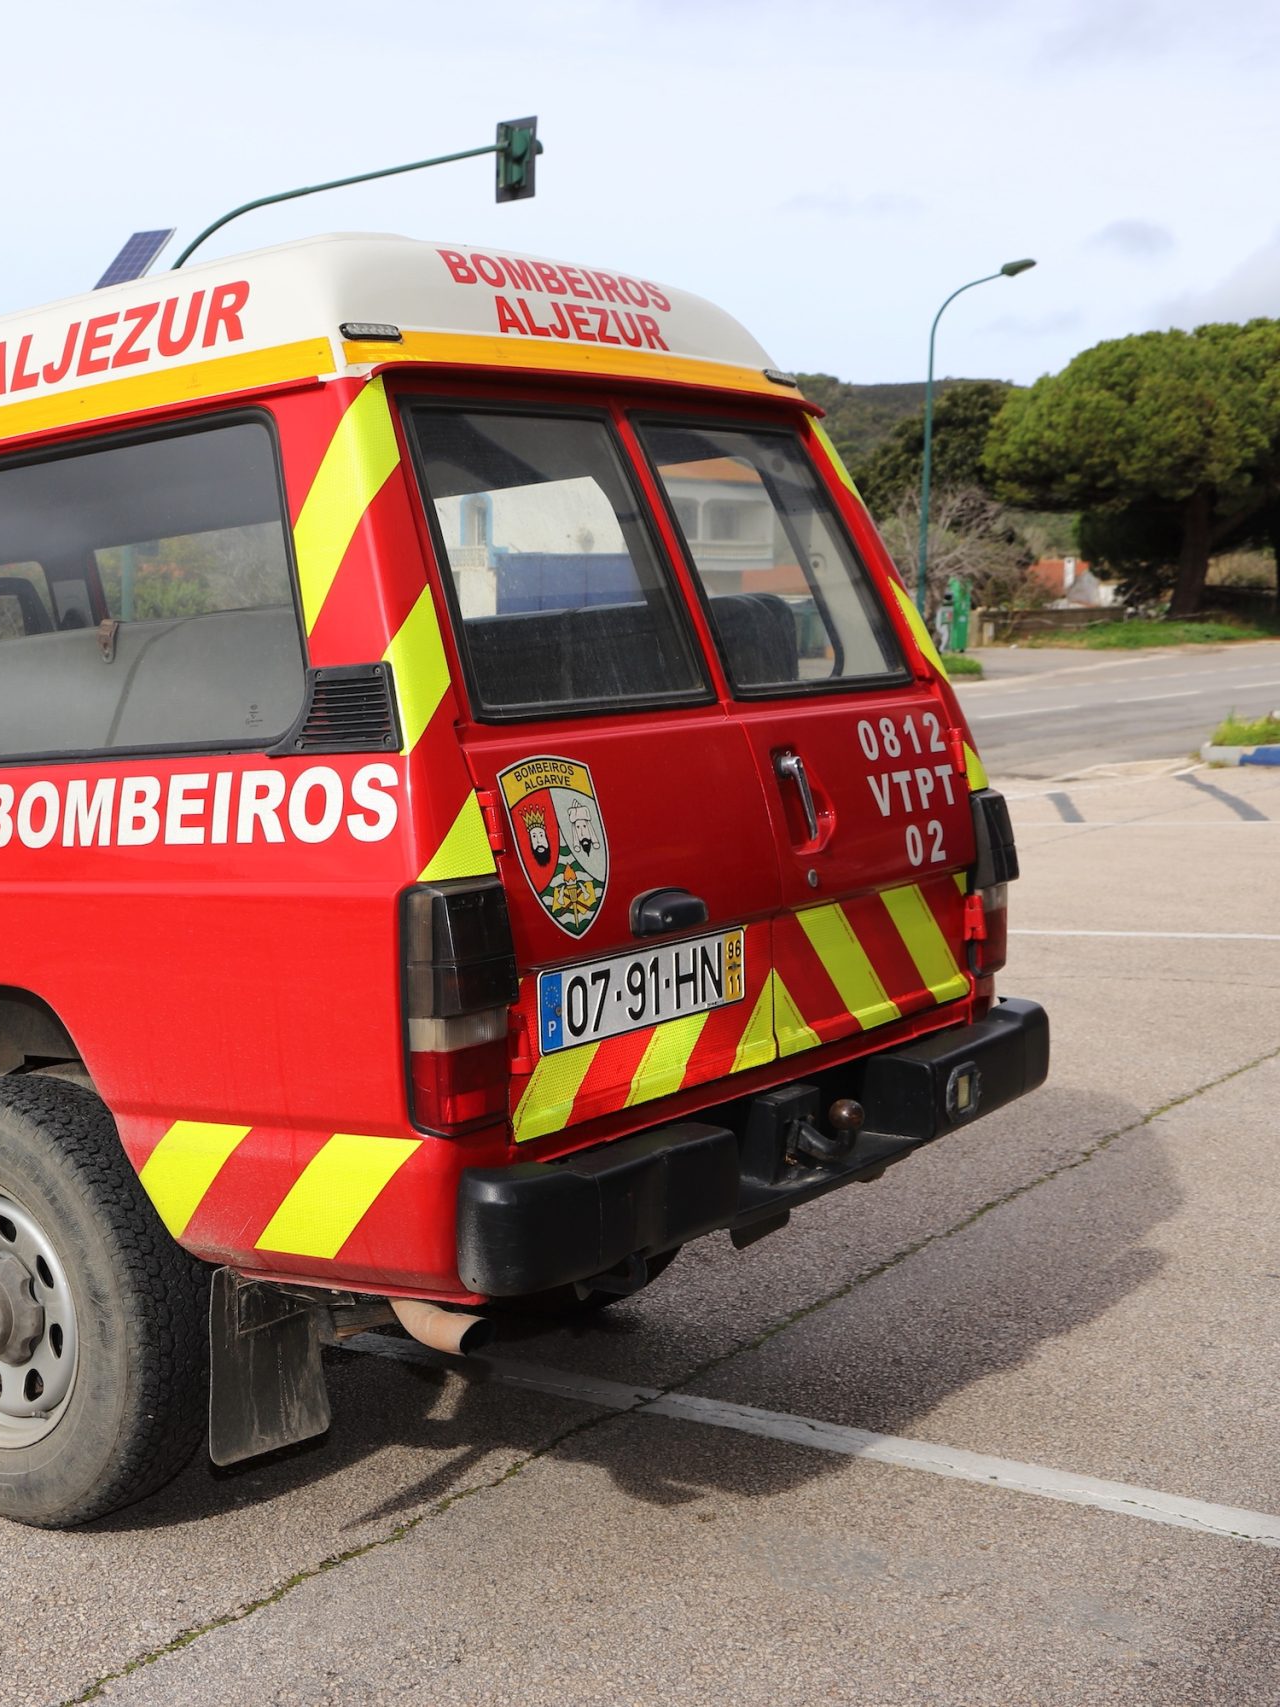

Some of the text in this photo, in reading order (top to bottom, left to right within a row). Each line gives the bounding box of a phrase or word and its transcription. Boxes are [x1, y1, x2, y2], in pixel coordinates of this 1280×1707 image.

[436, 249, 671, 312] BOMBEIROS
[495, 295, 671, 351] ALJEZUR
[857, 711, 947, 761] 0812
[514, 762, 574, 782] BOMBEIROS
[524, 775, 571, 792] ALGARVE
[866, 764, 955, 817] VTPT
[905, 820, 946, 867] 02
[728, 939, 741, 961] 96
[729, 974, 741, 995] 11
[548, 1020, 557, 1037] P
